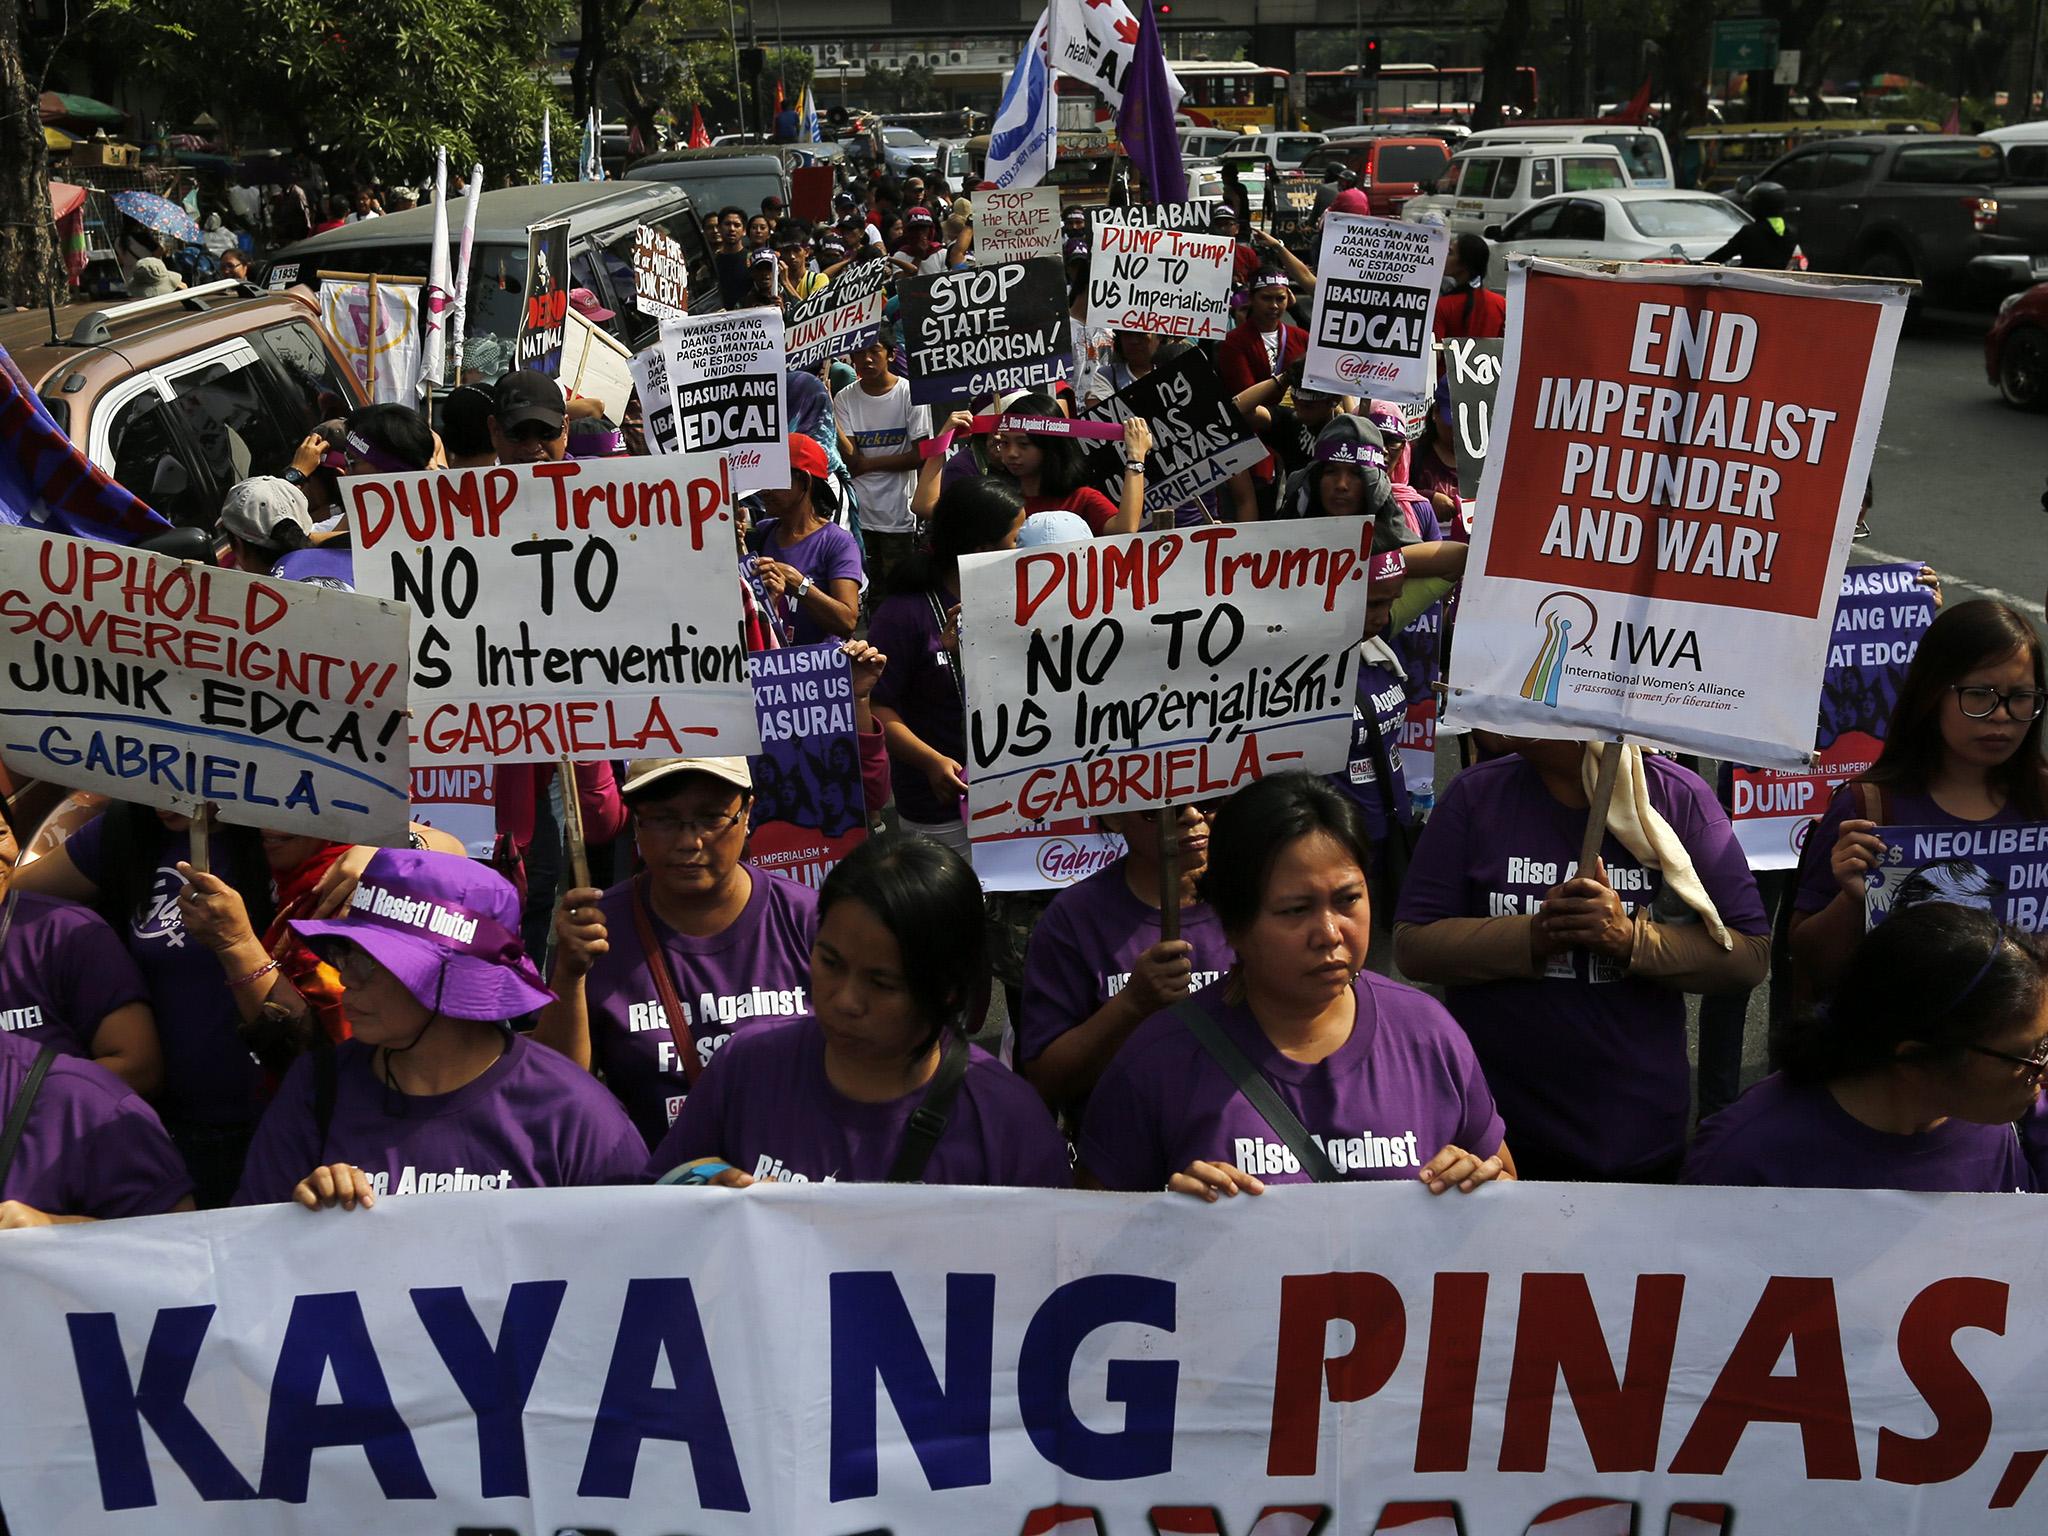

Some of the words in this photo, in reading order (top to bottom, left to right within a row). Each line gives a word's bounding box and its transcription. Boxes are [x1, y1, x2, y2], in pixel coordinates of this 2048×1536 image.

[981, 213, 1002, 227] the
[1007, 208, 1050, 226] RAPE
[987, 191, 1034, 211] STOP
[635, 223, 655, 250] STOP
[982, 228, 1060, 251] PATRIMONY!
[1101, 227, 1164, 254] DUMP
[1167, 231, 1235, 268] Trump!
[1341, 235, 1380, 248] DAANG
[1384, 239, 1409, 251] TAON
[1414, 244, 1430, 255] NA
[1346, 224, 1402, 240] WAKASAN
[1403, 232, 1429, 244] ANG
[832, 254, 890, 290] TROOPS
[1112, 253, 1149, 280] NO
[1157, 257, 1190, 285] TO
[1333, 245, 1435, 266] PAGSASAMANTALA
[1348, 258, 1364, 269] NG
[1367, 260, 1417, 274] ESTADOS
[930, 263, 1026, 314] STOP
[1358, 270, 1404, 283] UNIDOS!
[793, 291, 835, 323] OUT
[836, 272, 883, 306] NOW!
[1091, 279, 1122, 309] US
[1128, 283, 1231, 315] Imperialism!
[1326, 285, 1391, 307] IBASURA
[1392, 292, 1427, 311] ANG
[681, 334, 717, 349] DAANG
[720, 331, 748, 341] TAON
[750, 329, 767, 340] NA
[683, 321, 736, 338] WAKASAN
[738, 319, 762, 330] ANG
[785, 315, 830, 353] JUNK
[832, 292, 877, 333] VFA!
[921, 307, 1010, 346] STATE
[1320, 309, 1423, 352] EDCA!
[676, 340, 774, 362] PAGSASAMANTALA
[911, 320, 1062, 376] TERRORISM!
[1627, 300, 1761, 384] END
[692, 359, 707, 370] NG
[709, 352, 758, 366] ESTADOS
[703, 364, 747, 378] UNIDOS!
[1340, 358, 1400, 379] Gabriela
[679, 384, 739, 409] IBASURA
[741, 381, 776, 397] ANG
[1156, 371, 1193, 408] ng
[683, 404, 776, 450] EDCA!
[1534, 376, 1838, 465] IMPERIALIST
[1559, 441, 1782, 521] PLUNDER
[351, 468, 519, 550] DUMP
[532, 456, 732, 551] Trump!
[1539, 504, 1645, 566] AND
[1655, 517, 1781, 584] WAR!
[39, 539, 289, 636] UPHOLD
[391, 544, 479, 620] NO
[511, 534, 619, 616] TO
[1014, 533, 1183, 627] DUMP
[1190, 520, 1375, 612] Trump!
[1835, 607, 1885, 632] ANG
[1890, 604, 1932, 629] VFA
[0, 589, 399, 709] SOVEREIGNTY!
[475, 619, 753, 689] Intervention!
[1025, 617, 1125, 697] NO
[1151, 602, 1246, 670] TO
[1609, 620, 1703, 672] IWA
[1828, 643, 1856, 668] AT
[792, 680, 820, 703] NG
[824, 677, 850, 699] US
[1565, 664, 1640, 685] International
[1642, 676, 1696, 692] Women's
[1697, 682, 1746, 698] Alliance
[1574, 682, 1626, 699] grassroots
[1628, 692, 1663, 702] women
[1660, 692, 1681, 706] for
[1682, 695, 1732, 711] liberation
[8, 639, 172, 716] JUNK
[199, 678, 404, 764] EDCA!
[970, 698, 1052, 769] US
[1074, 651, 1352, 749] Imperialism!
[760, 702, 854, 743] ASURA!
[1825, 763, 1837, 774] US
[1734, 779, 1814, 815] DUMP
[760, 847, 821, 866] IMPERIALISM
[1507, 856, 1558, 885] Rise
[371, 887, 433, 928] Resist!
[428, 904, 480, 945] Unite!
[700, 986, 809, 1025] Against
[65, 1277, 751, 1513] KAYA
[828, 1271, 1180, 1503] NG
[1265, 1271, 2048, 1510] PINAS,
